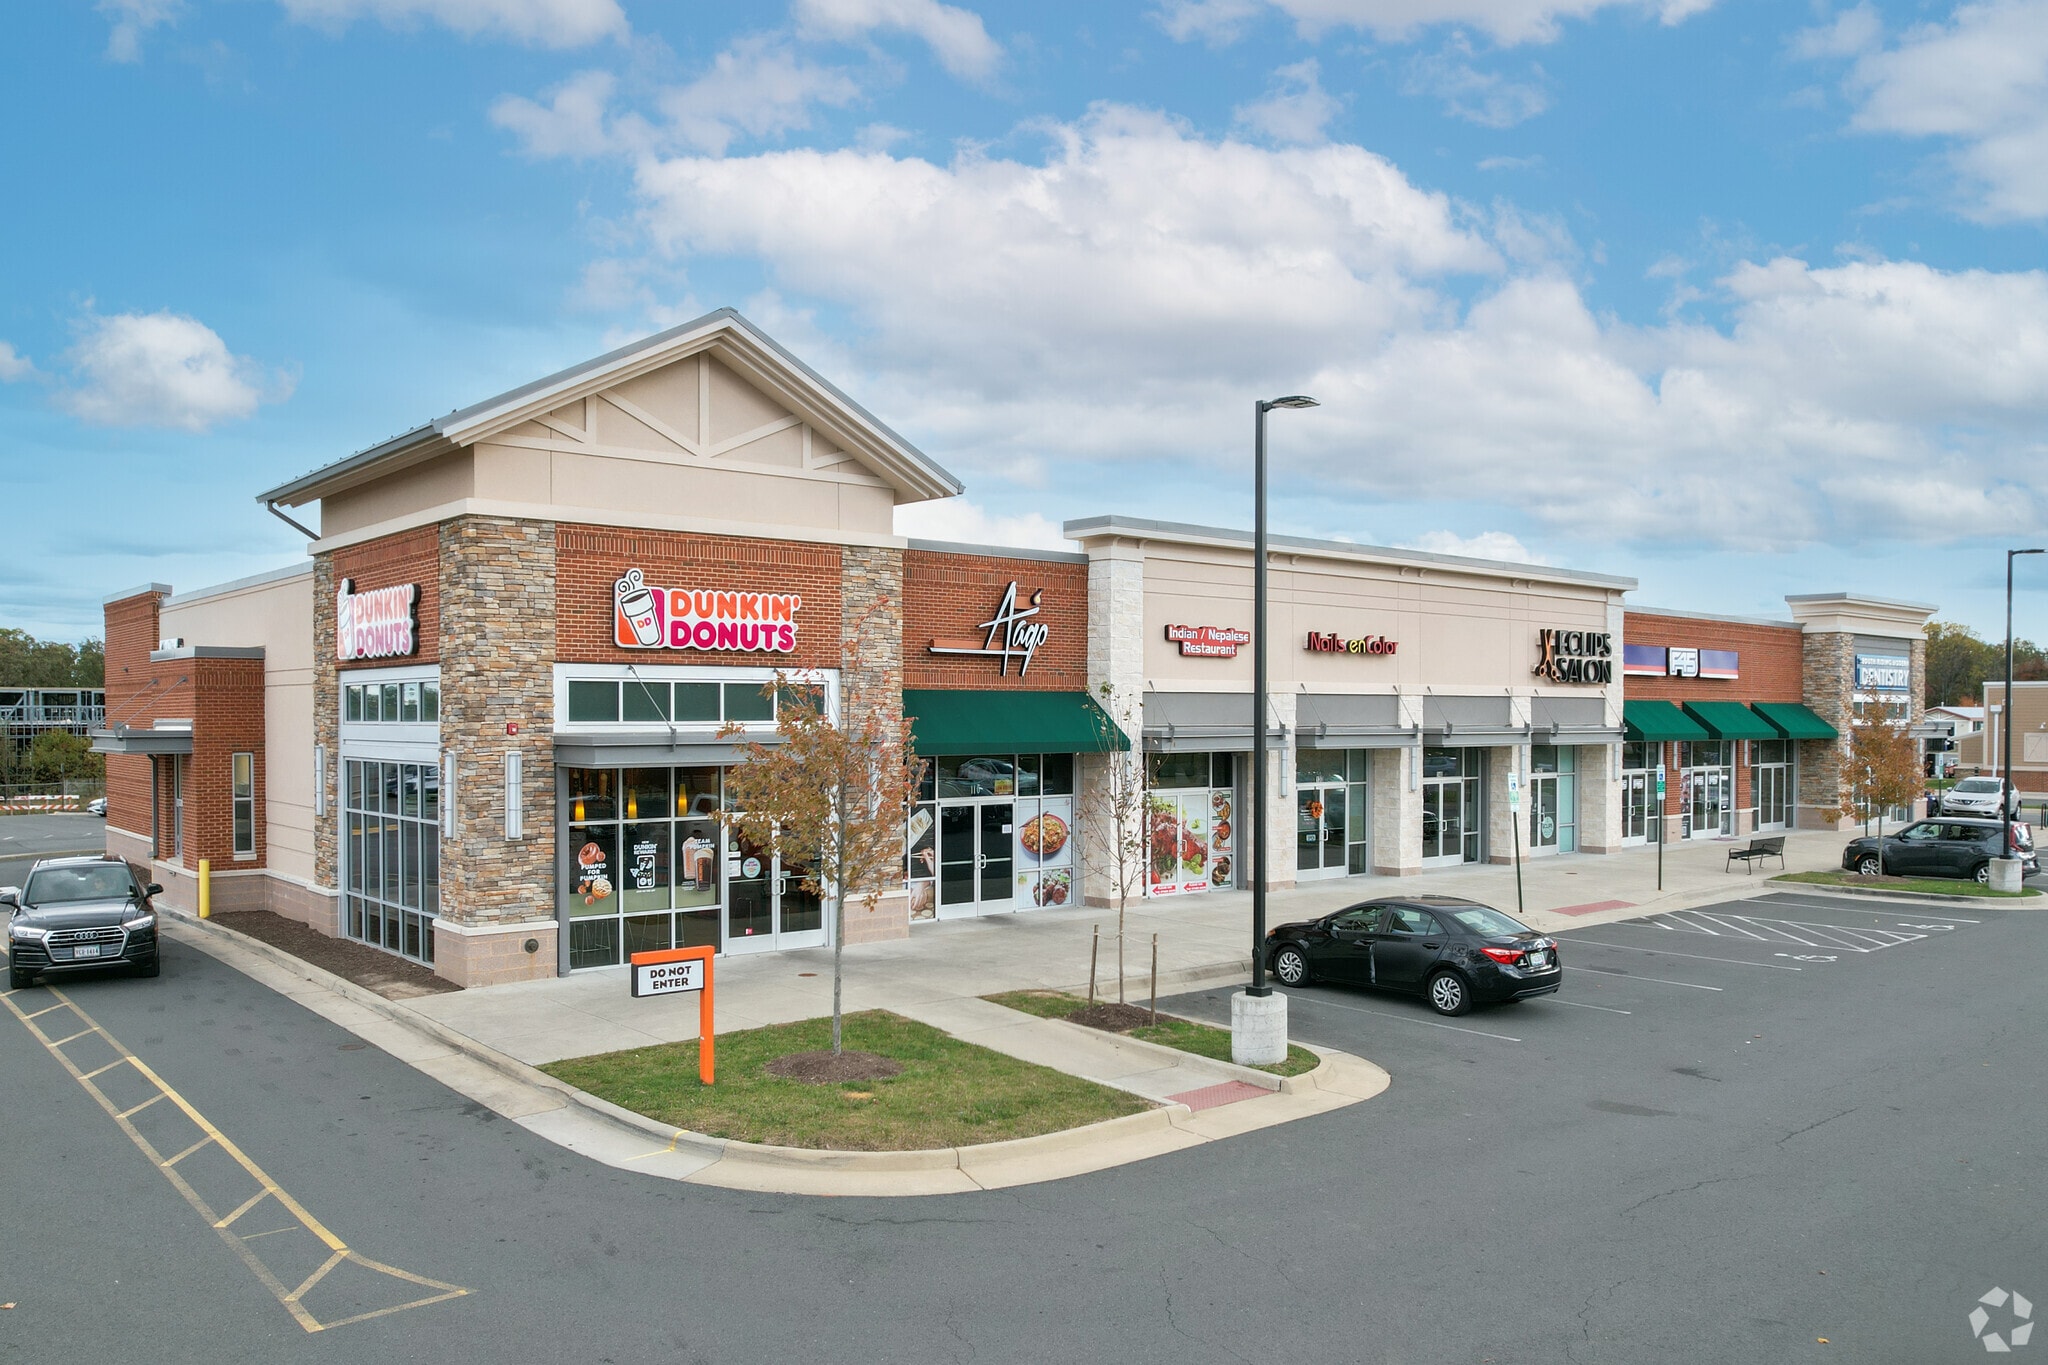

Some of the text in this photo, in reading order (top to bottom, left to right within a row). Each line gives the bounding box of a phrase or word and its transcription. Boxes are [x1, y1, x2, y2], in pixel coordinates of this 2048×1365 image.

[355, 588, 412, 625] DUNKIN'
[670, 590, 799, 622] DUNKIN'
[637, 617, 652, 629] DD
[670, 620, 794, 650] DONUTS
[978, 580, 1049, 677] Aago
[1169, 626, 1198, 640] Indian
[1208, 628, 1249, 643] Nepalese
[356, 620, 410, 656] DONUTS
[1183, 641, 1236, 655] Restaurant
[1308, 631, 1346, 653] Nails
[1556, 630, 1612, 657] ECLIPS
[1556, 658, 1612, 683] SALON
[1671, 648, 1698, 677] F45
[650, 966, 692, 979] DO NOT
[653, 977, 689, 990] ENTER
